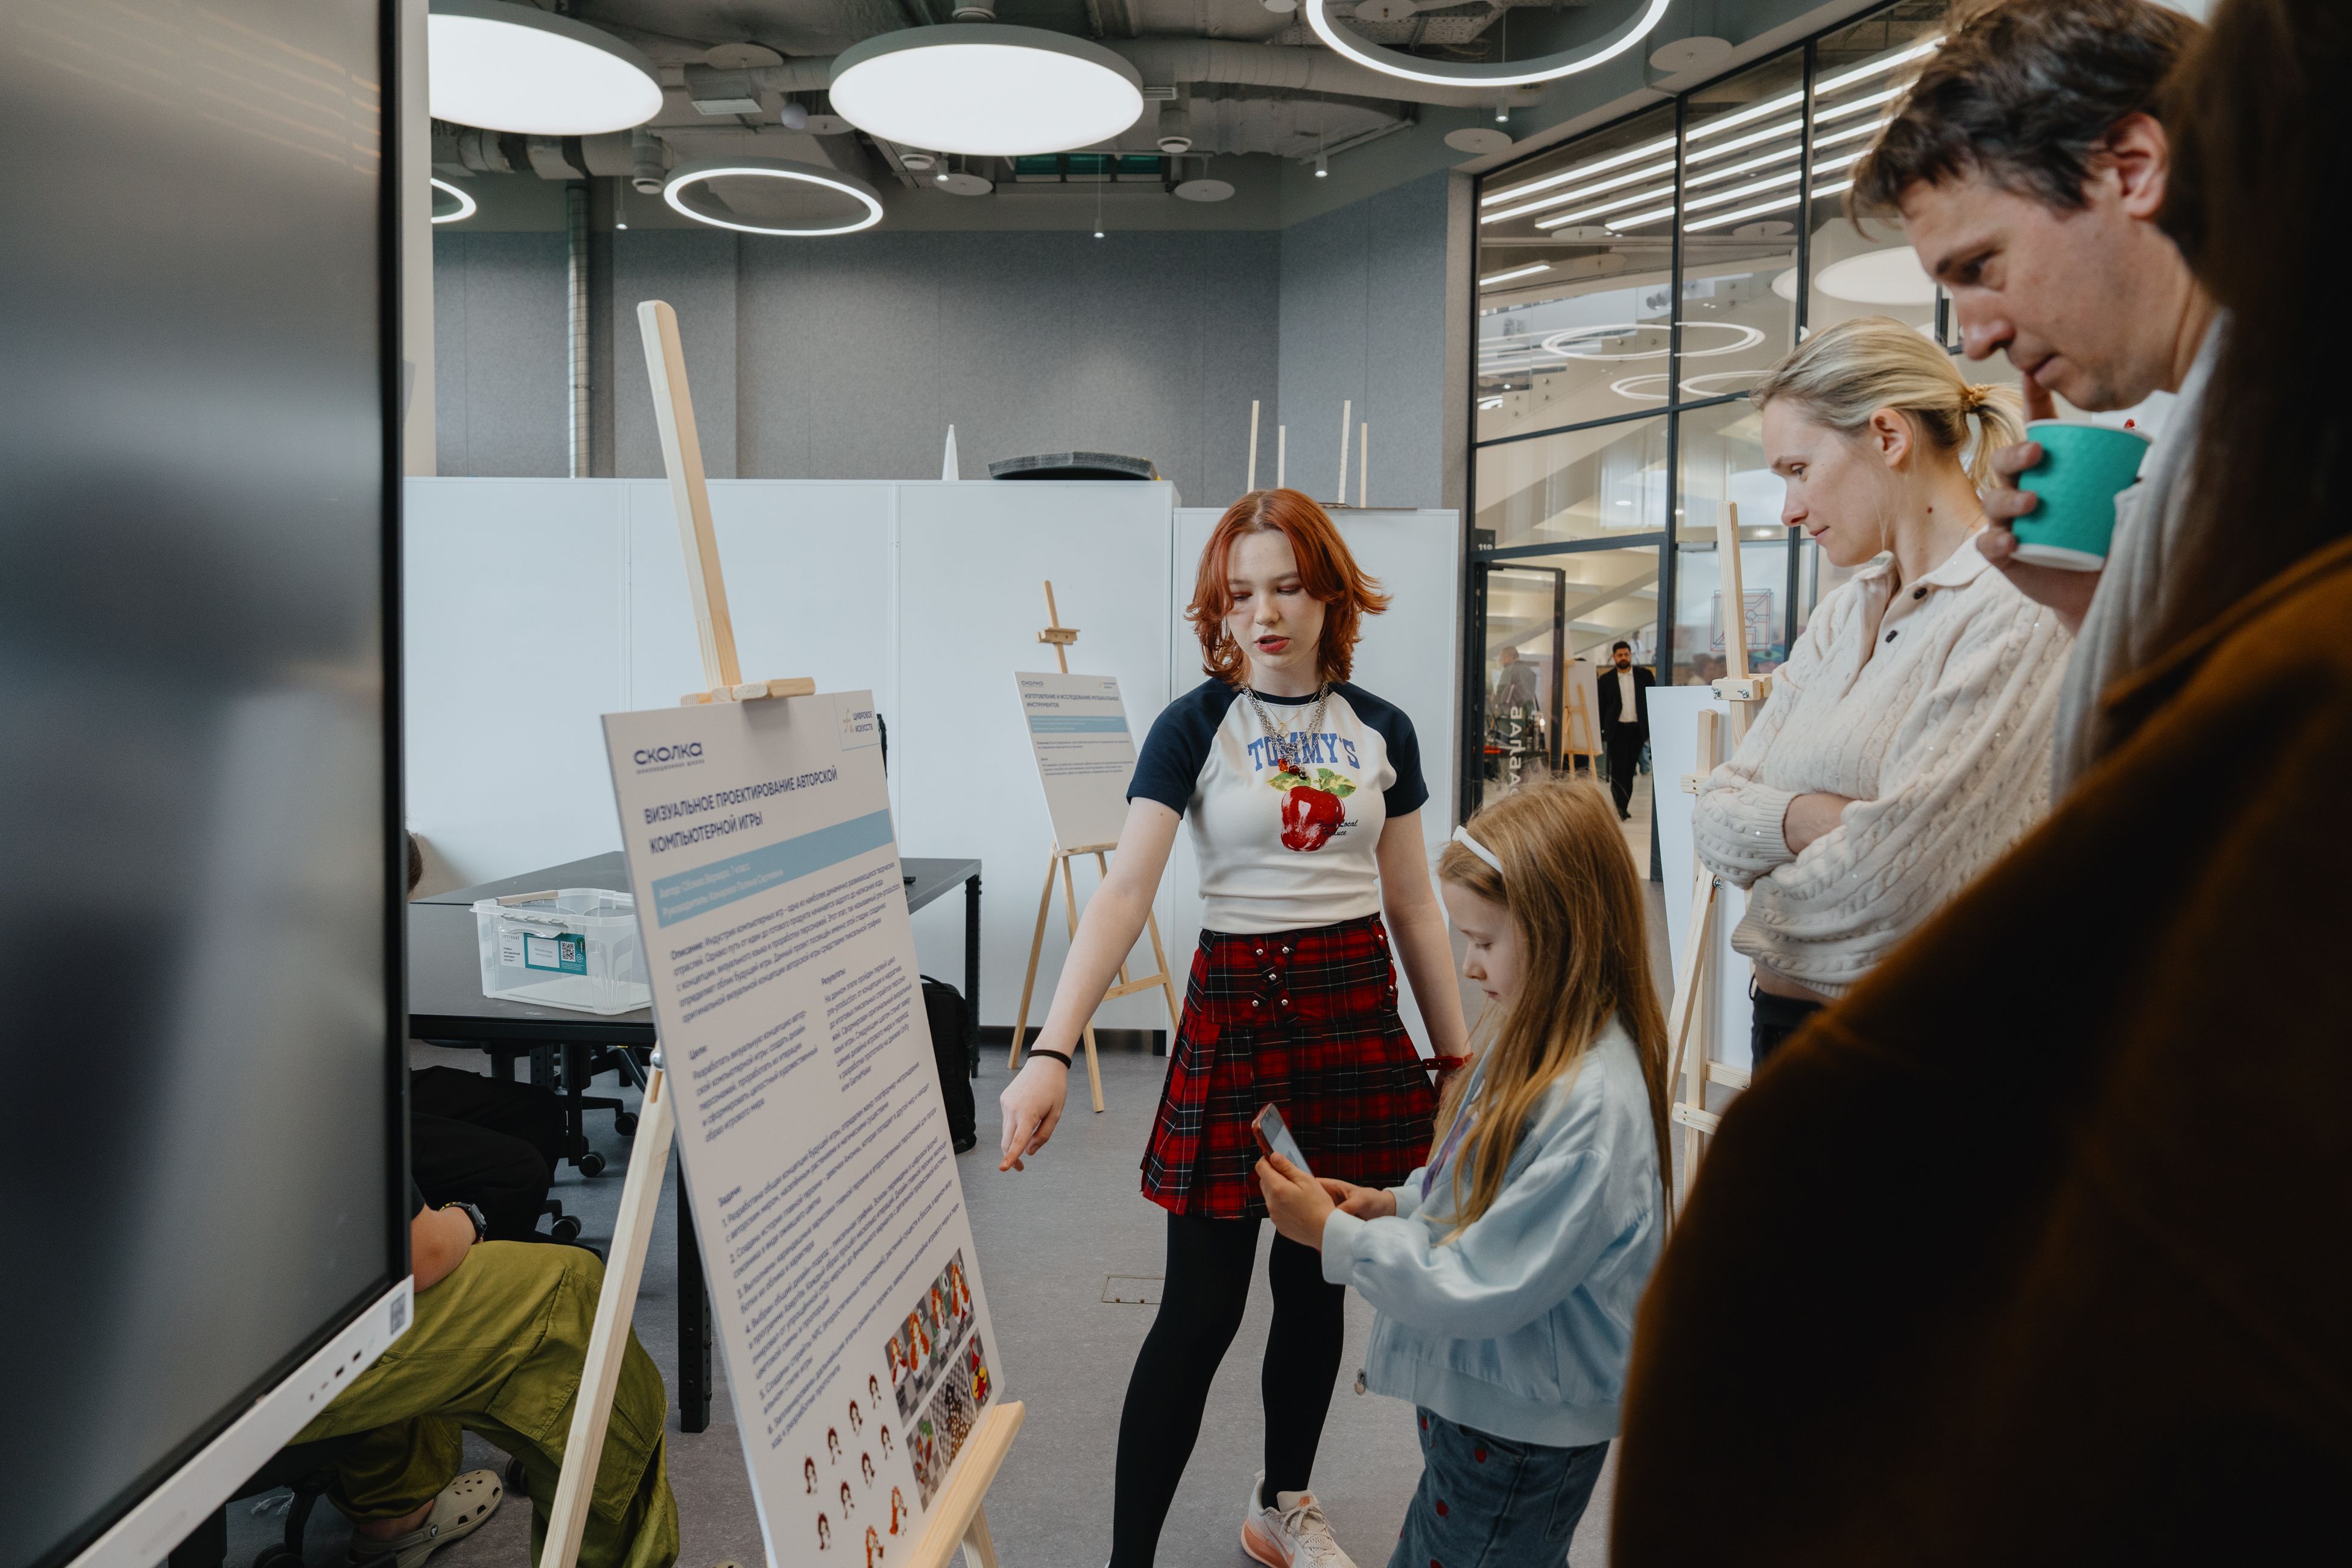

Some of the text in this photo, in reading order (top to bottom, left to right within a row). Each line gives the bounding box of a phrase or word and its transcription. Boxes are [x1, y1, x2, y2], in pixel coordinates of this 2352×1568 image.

[853, 711, 873, 720] ЦИФРОВОЕ
[644, 763, 838, 824] ВИЗУАЛЬНОЕ ПРОЕКТИРОВАНИЕ АВТОРСКОЙ
[650, 811, 763, 855] КОМПЬЮТЕРНОЙ ИГРЫ
